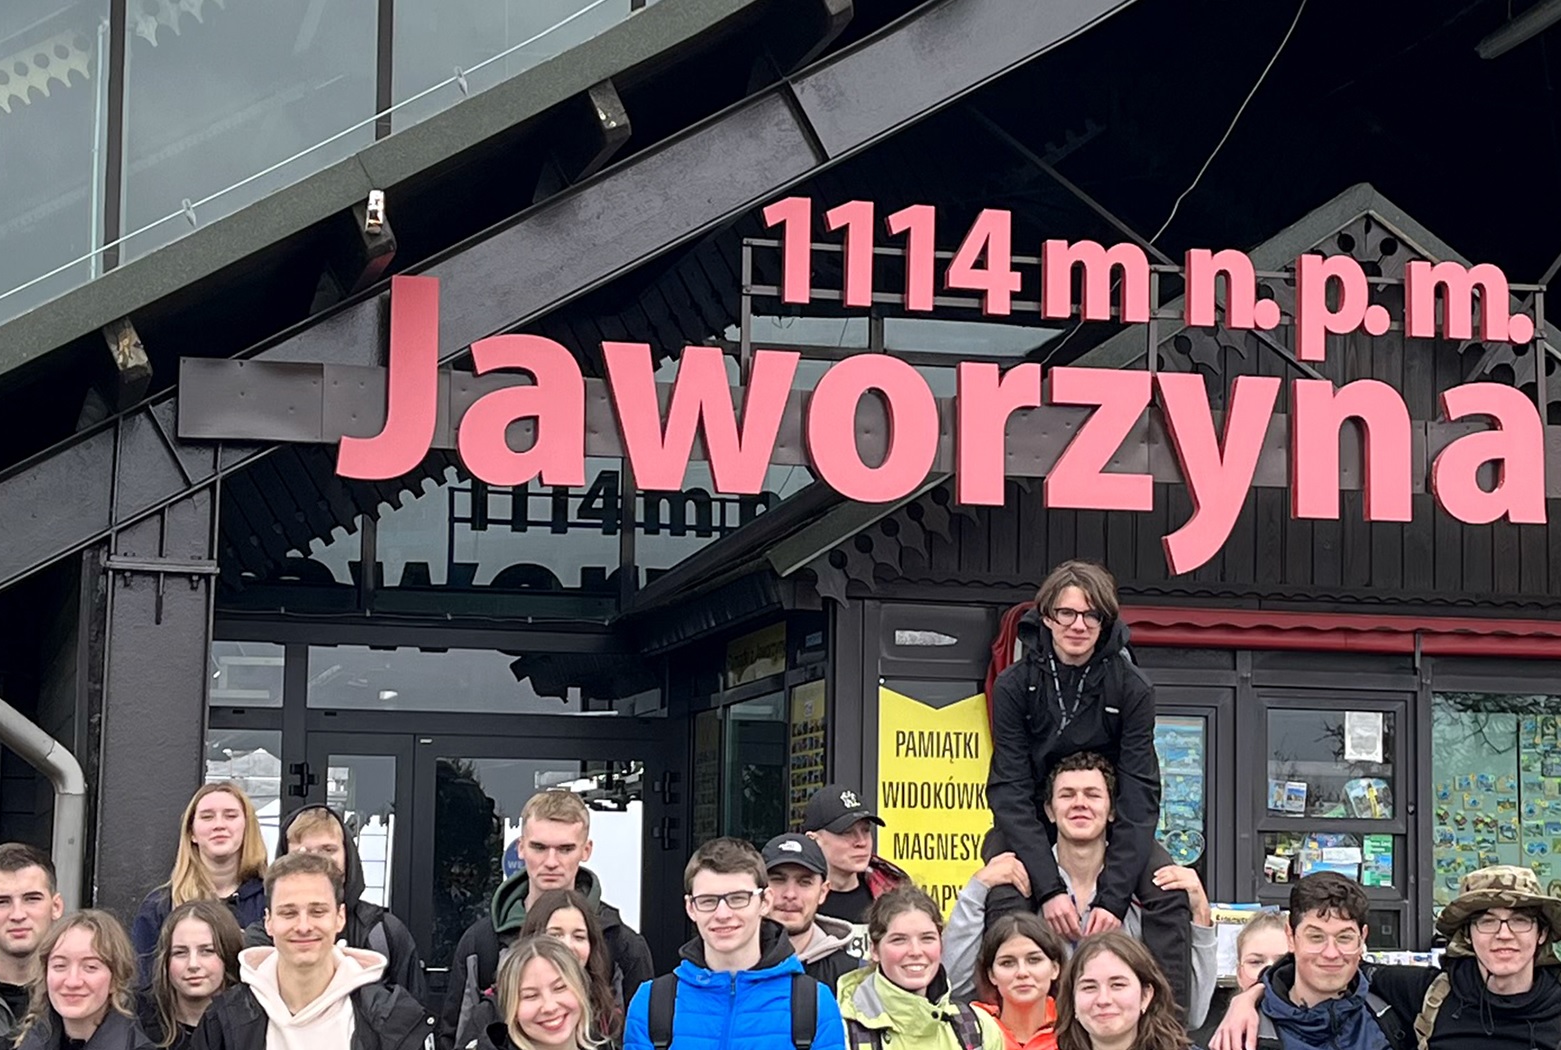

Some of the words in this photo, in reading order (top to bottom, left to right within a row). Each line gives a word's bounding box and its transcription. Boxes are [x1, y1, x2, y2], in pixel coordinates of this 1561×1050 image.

[763, 197, 1022, 316] 1114
[1040, 240, 1151, 322] m
[1183, 247, 1280, 330] n.
[1297, 253, 1390, 363] p.
[1405, 258, 1534, 344] m.
[336, 274, 1546, 575] Jaworzyna
[895, 730, 979, 763] PAMIĄTKI
[882, 776, 990, 810] WIDOKÓWK
[894, 833, 981, 861] MAGNESY
